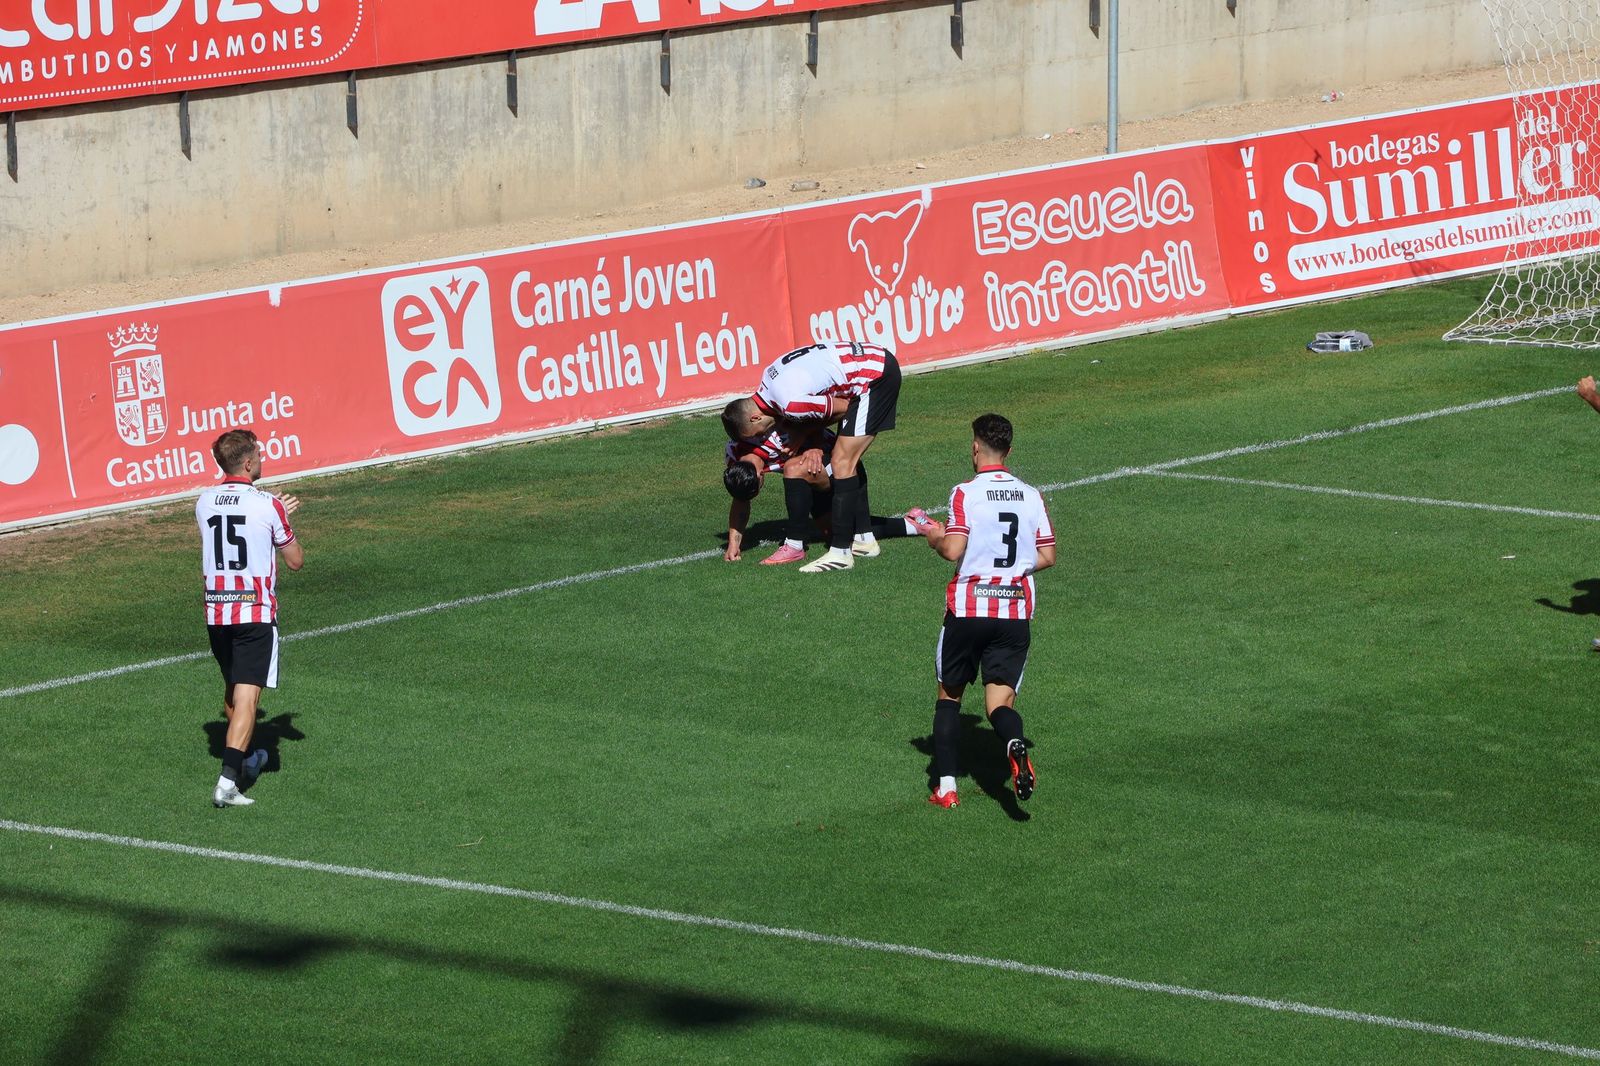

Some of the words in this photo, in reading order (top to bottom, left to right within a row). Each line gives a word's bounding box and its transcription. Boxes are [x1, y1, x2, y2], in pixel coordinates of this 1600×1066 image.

[166, 44, 177, 64] Y
[189, 26, 323, 62] JAMONES
[1329, 132, 1440, 169] bodegas
[1520, 107, 1560, 139] del
[1283, 127, 1588, 235] Sumiller
[973, 171, 1195, 255] Escuela
[1294, 208, 1593, 272] www.bodegasdelsumiller.com
[510, 257, 611, 329] Carné
[620, 255, 716, 313] Joven
[983, 240, 1206, 332] infantil
[518, 329, 645, 402] Castilla
[648, 339, 668, 398] y
[675, 312, 760, 377] León
[177, 400, 254, 436] Junta
[261, 391, 294, 421] de
[106, 447, 206, 488] Castilla
[986, 487, 1025, 502] MERCHÁN
[214, 494, 241, 506] LOREN
[206, 514, 248, 571] 15
[993, 512, 1019, 568] 3
[205, 592, 257, 602] leomotor.net
